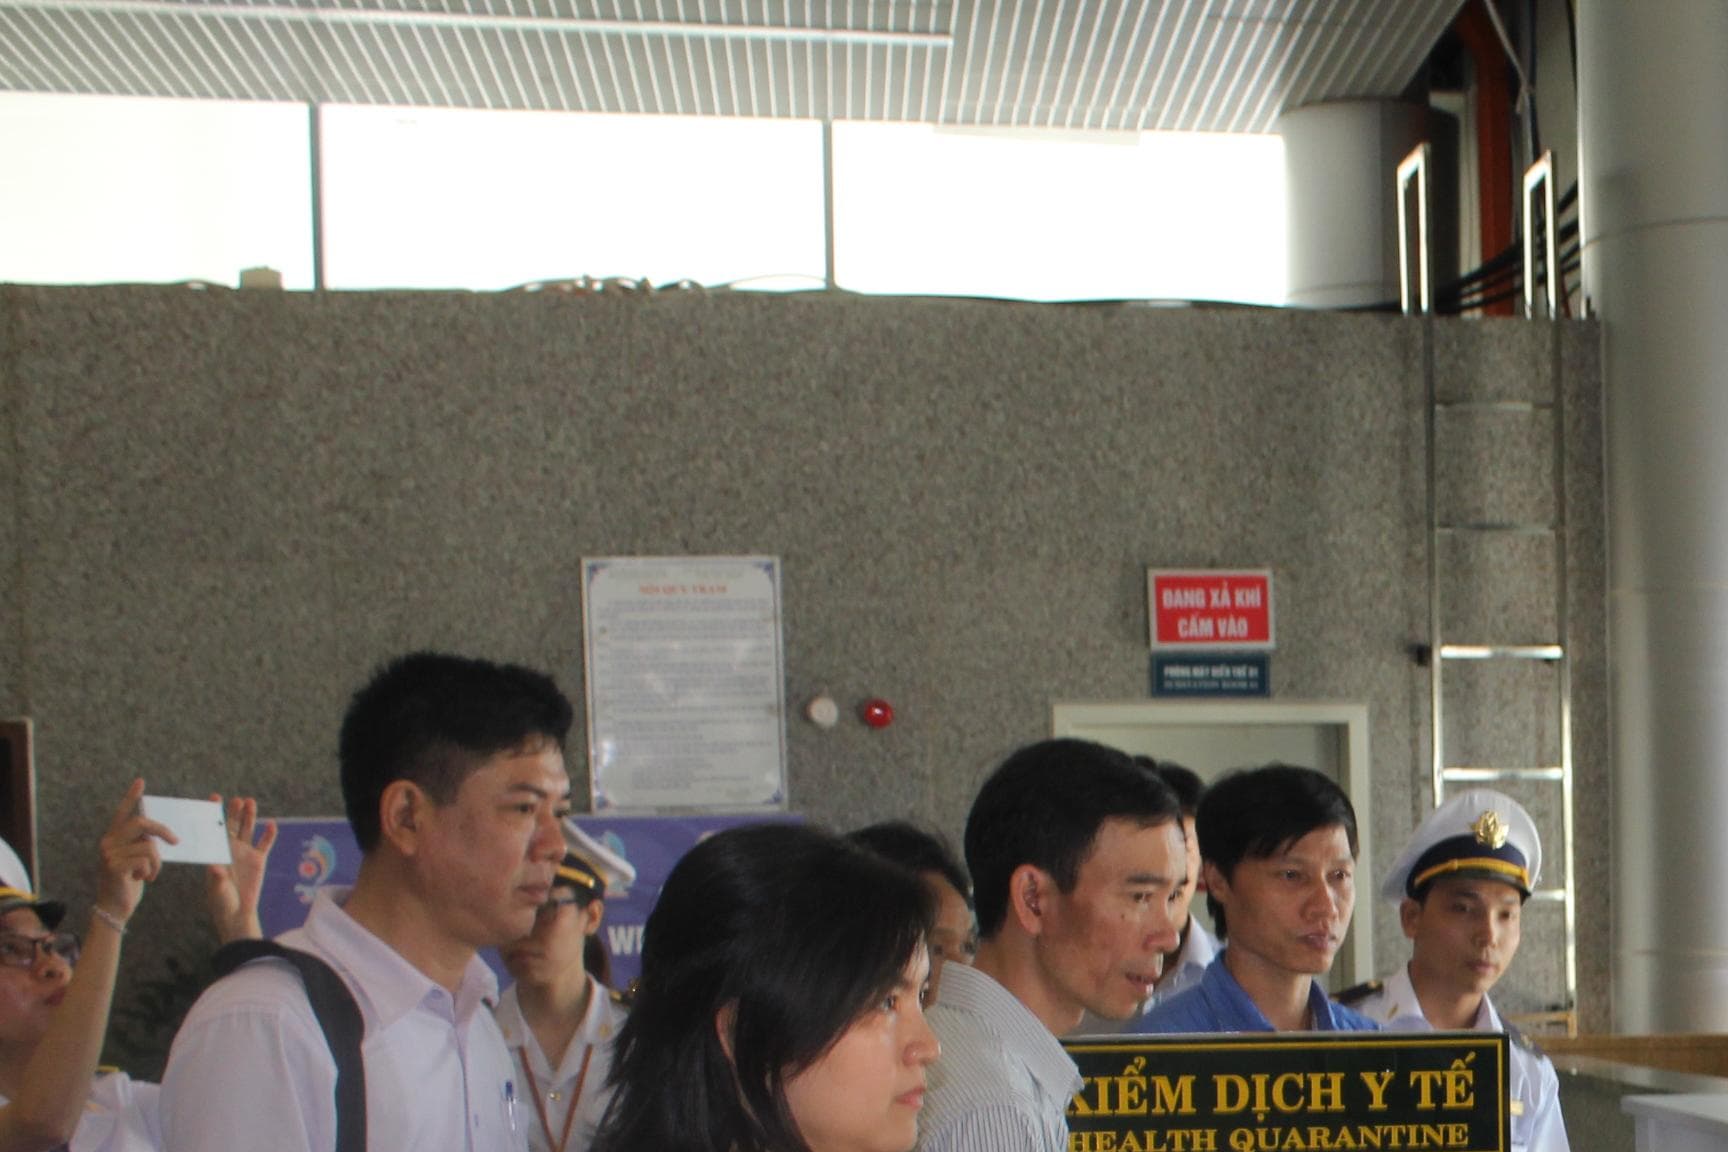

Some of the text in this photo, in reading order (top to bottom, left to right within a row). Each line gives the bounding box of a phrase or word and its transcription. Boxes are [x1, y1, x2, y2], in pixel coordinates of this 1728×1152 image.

[1217, 613, 1249, 638] VÀO
[1212, 1072, 1346, 1122] DỊCH
[1360, 1070, 1396, 1111] Y
[1410, 1051, 1476, 1110] TẾ
